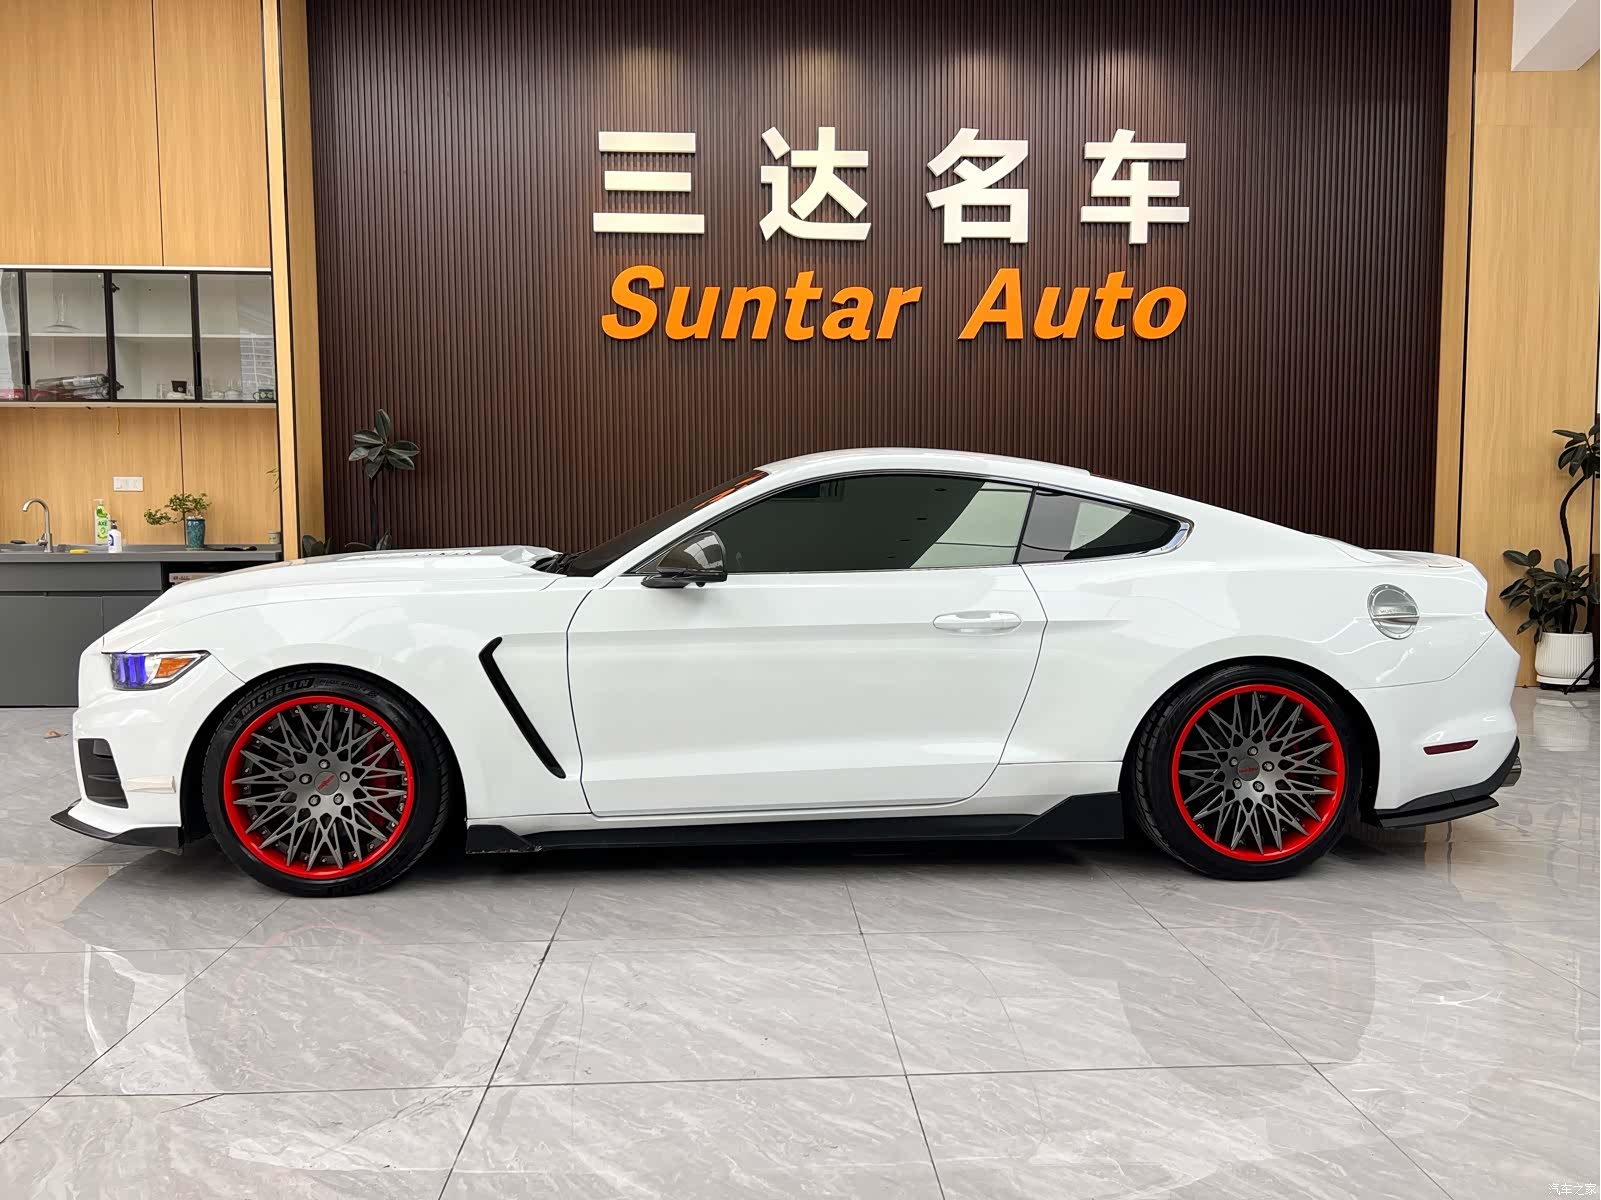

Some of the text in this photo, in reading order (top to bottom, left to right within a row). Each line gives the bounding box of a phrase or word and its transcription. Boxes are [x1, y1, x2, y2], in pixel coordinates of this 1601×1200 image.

[593, 127, 1189, 243] 三达名车
[602, 265, 1186, 340] Suntar Auto
[242, 679, 311, 717] MICHELIN
